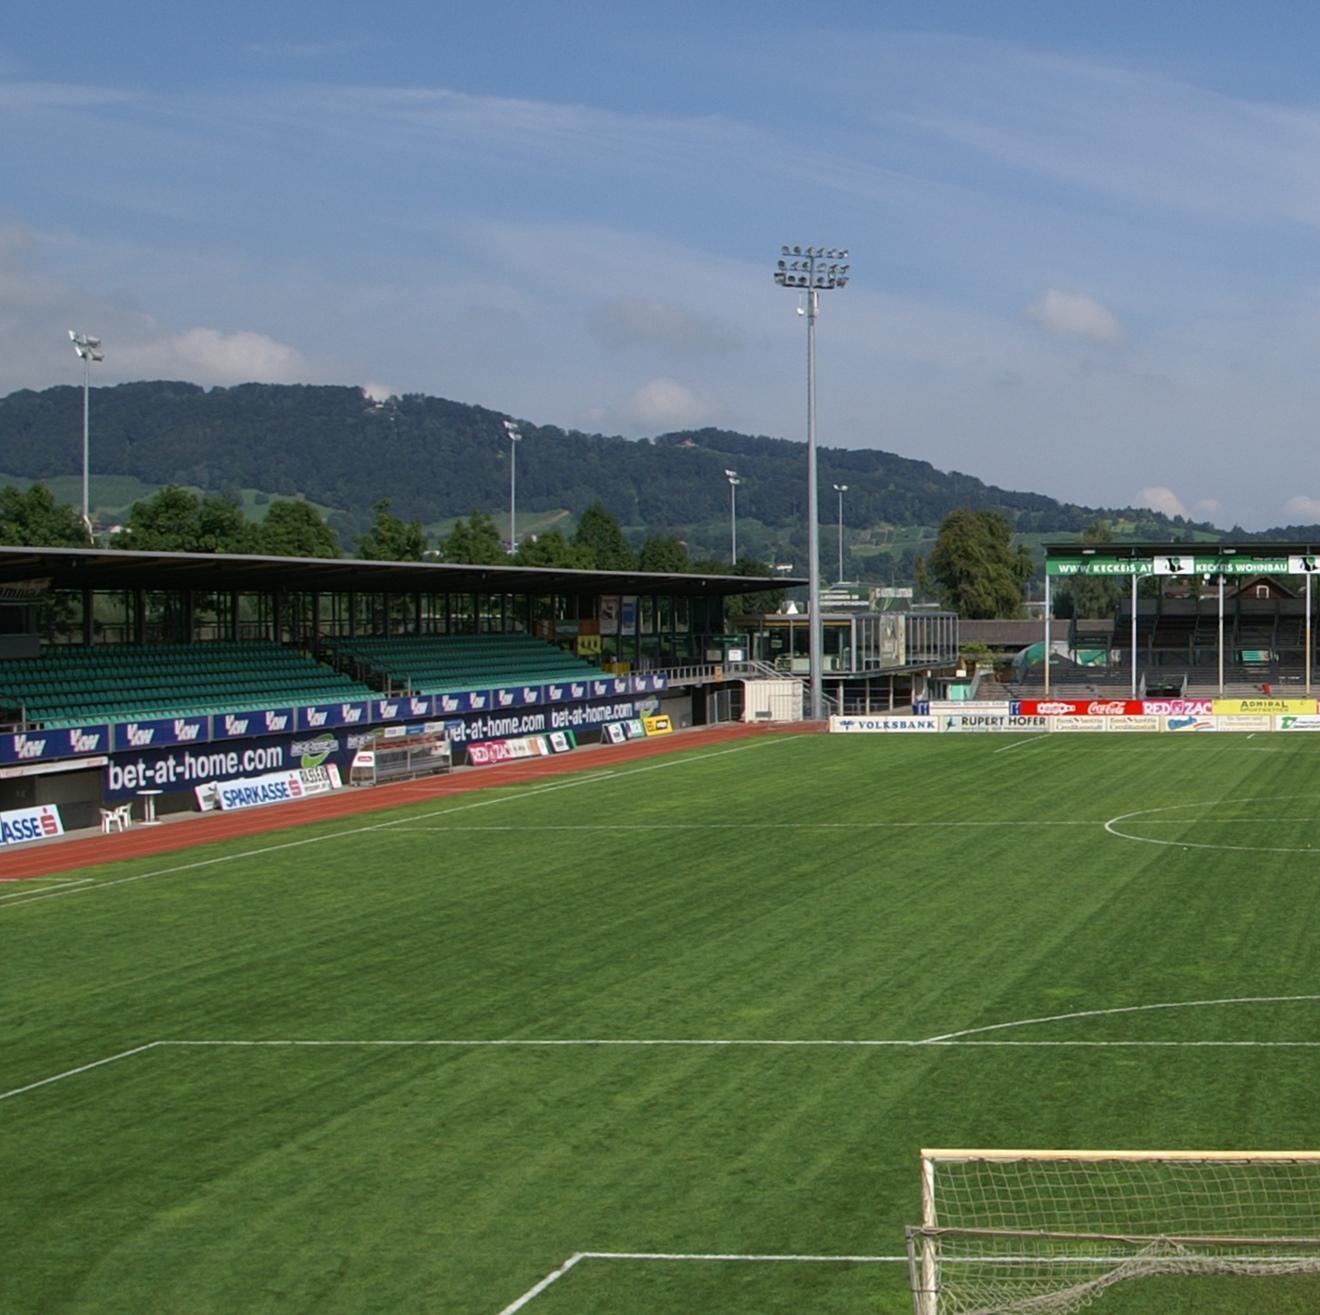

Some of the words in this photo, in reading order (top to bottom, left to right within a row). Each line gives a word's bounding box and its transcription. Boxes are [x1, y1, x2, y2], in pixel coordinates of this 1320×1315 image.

[551, 702, 633, 728] bet-at-home.com
[1142, 702, 1170, 715] RED
[1185, 702, 1212, 715] ZAC
[858, 720, 936, 729] VOLKSBANK
[962, 716, 1004, 726] RUPERT
[1008, 716, 1046, 726] HOFER
[109, 746, 283, 791] bet-at-home.com
[223, 782, 290, 807] SPARKASSE
